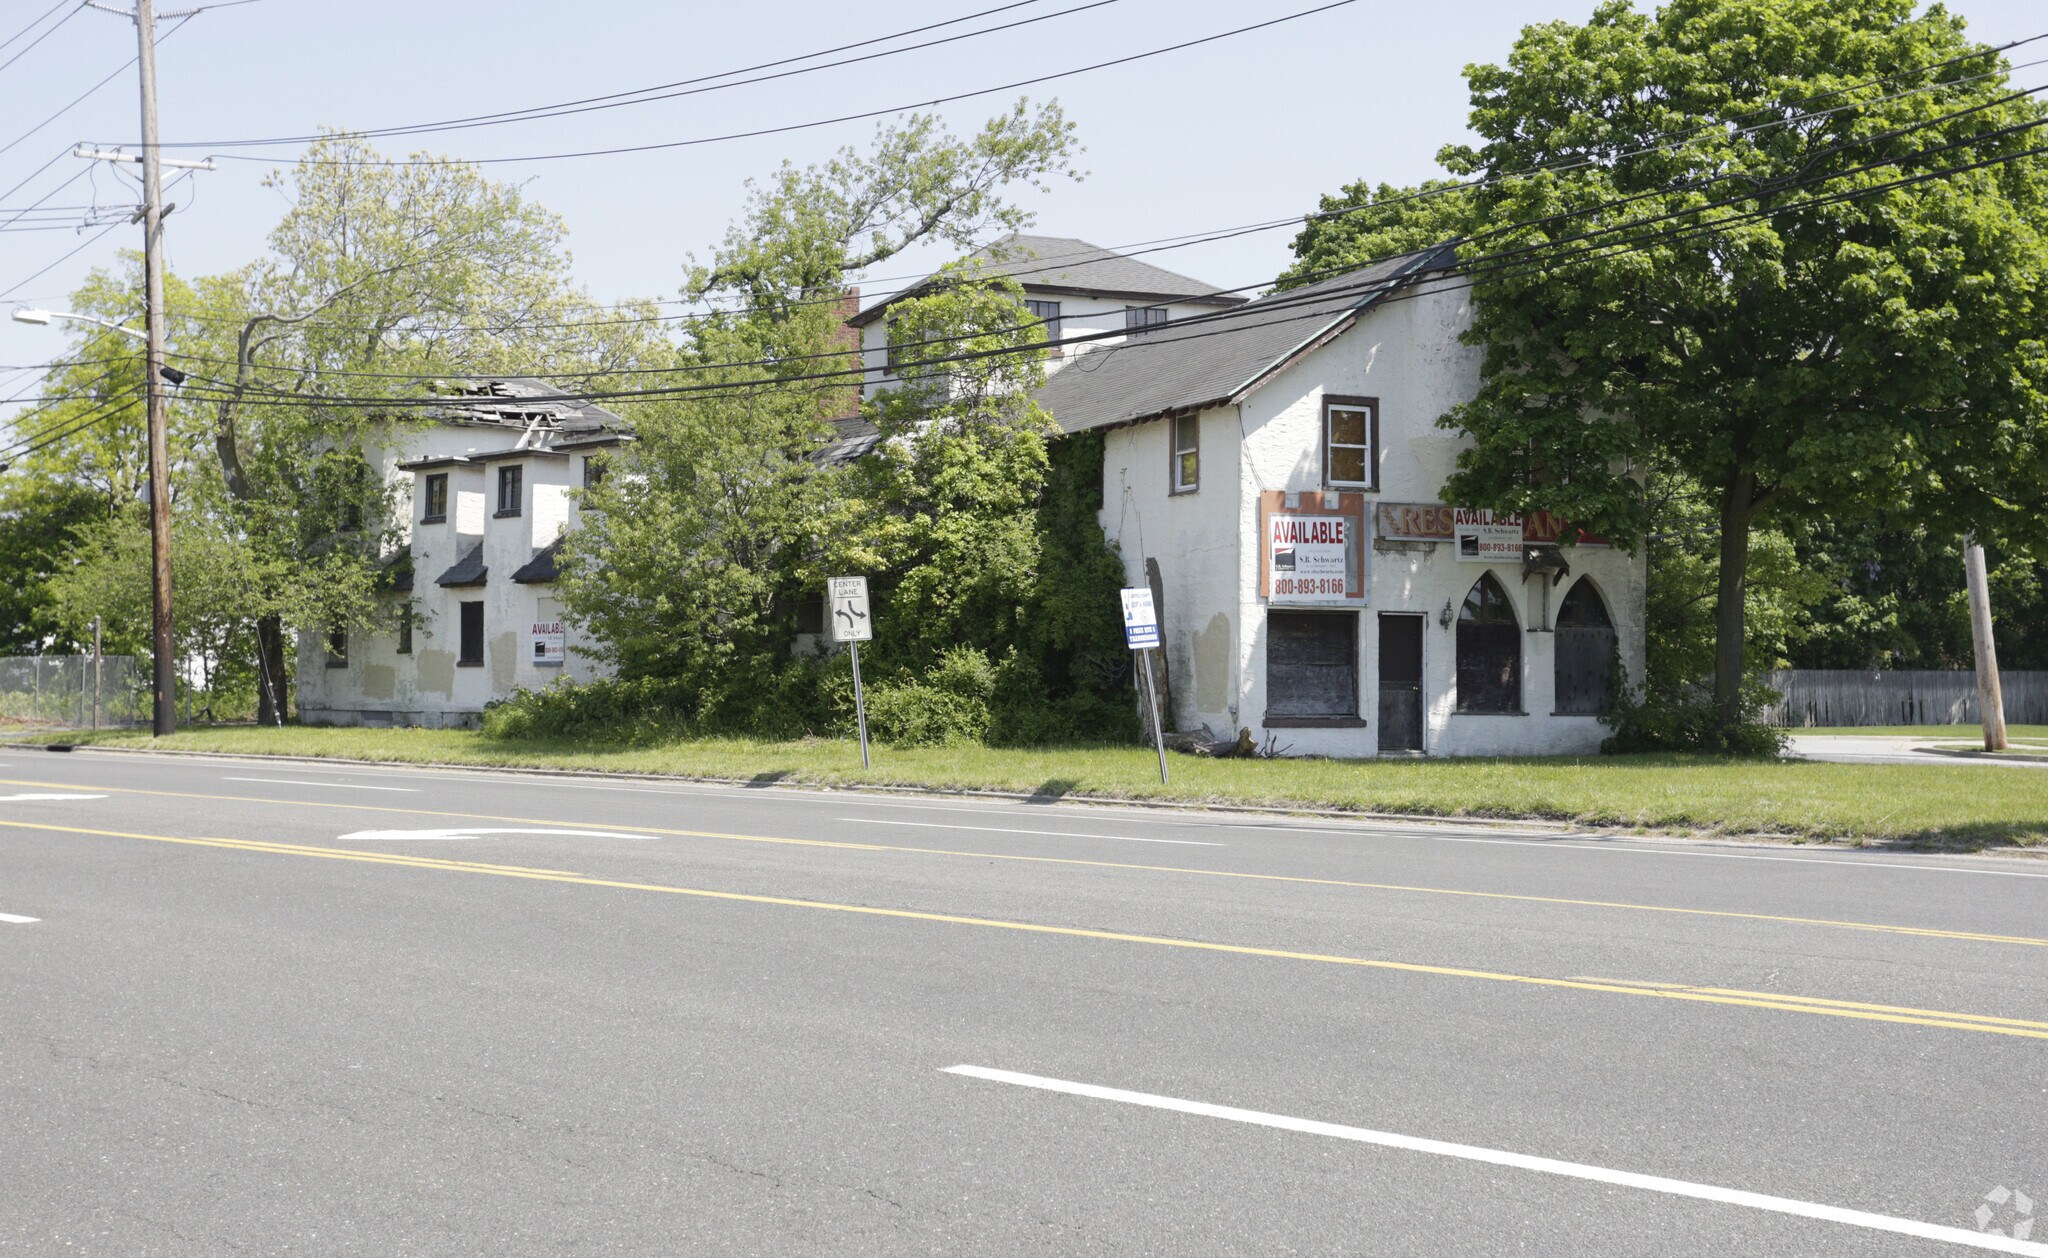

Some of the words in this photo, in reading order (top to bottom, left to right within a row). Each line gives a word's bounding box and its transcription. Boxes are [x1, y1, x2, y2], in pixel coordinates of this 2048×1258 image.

[1274, 521, 1343, 544] AVAILABLE
[1494, 527, 1520, 535] Schwartz
[1479, 543, 1522, 553] 800-893-8166
[1313, 555, 1344, 564] Schwartz
[833, 580, 861, 588] CENTER
[1275, 578, 1343, 594] 800-893-8166
